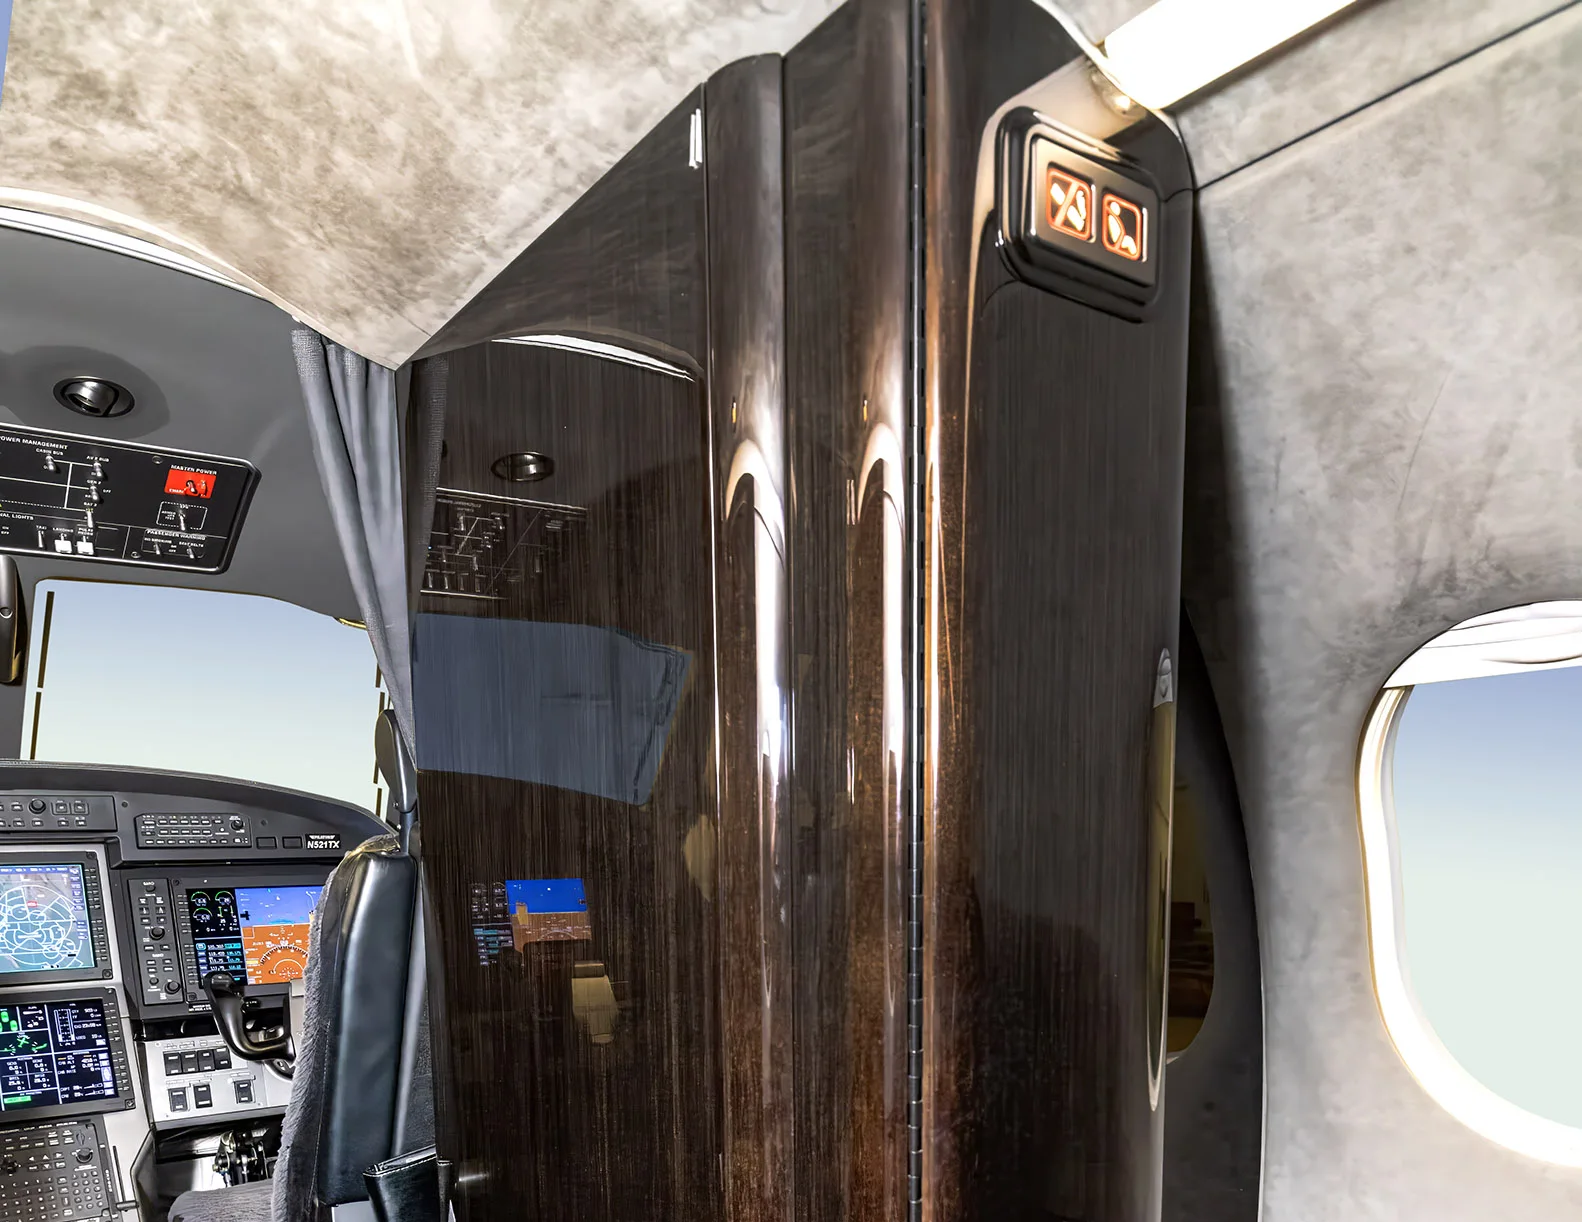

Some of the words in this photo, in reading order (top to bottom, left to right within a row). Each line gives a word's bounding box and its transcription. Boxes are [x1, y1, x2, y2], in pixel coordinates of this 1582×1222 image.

[22, 439, 68, 450] MANAGEMENT
[170, 464, 195, 473] MASTER
[307, 840, 340, 849] N521TX
